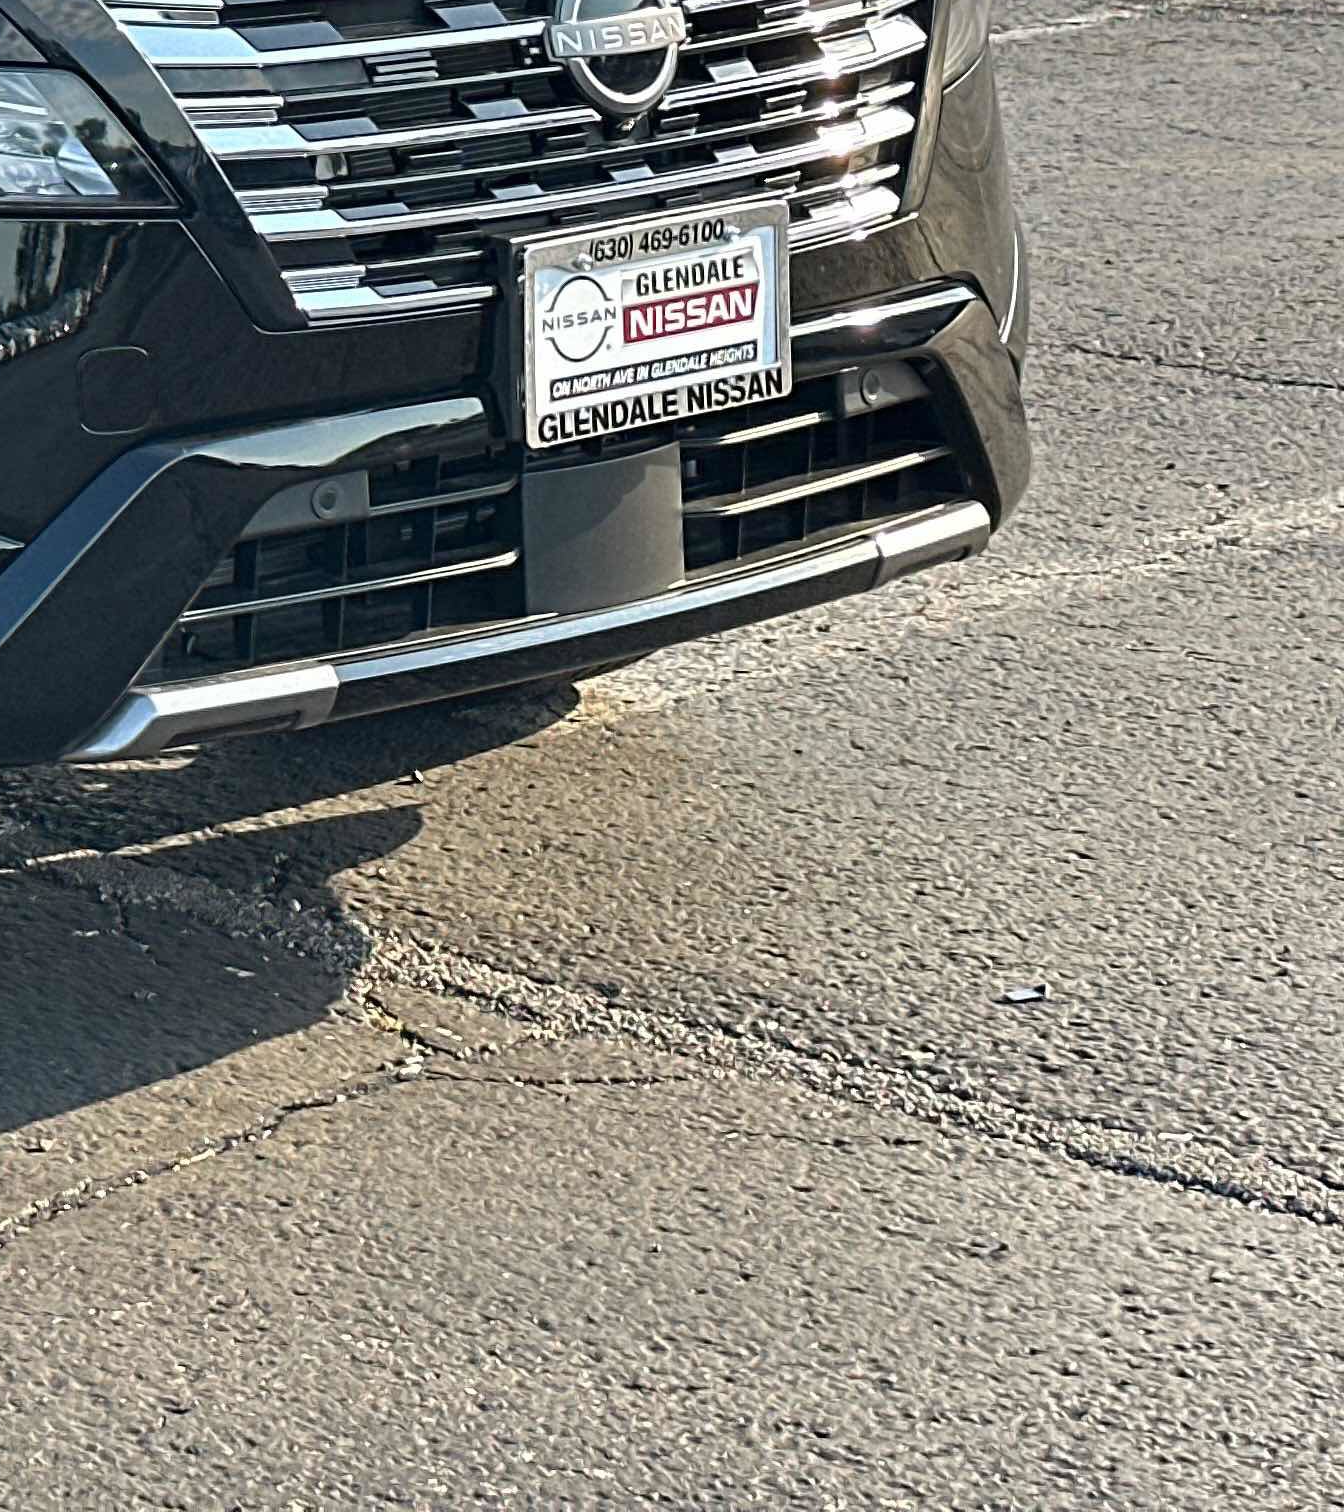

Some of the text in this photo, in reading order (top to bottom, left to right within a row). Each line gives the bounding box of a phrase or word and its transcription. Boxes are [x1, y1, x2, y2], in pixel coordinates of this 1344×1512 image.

[556, 16, 684, 54] NISSAN
[589, 218, 725, 263] (630) 469-6100
[636, 254, 745, 297] GLENDALE
[542, 305, 617, 333] NISSAN
[628, 288, 753, 340] NISSAN
[552, 343, 755, 398] ON NORTH AVE IN GLENDALE HEIGHTS
[538, 368, 783, 444] GLENDALE NISSAN
